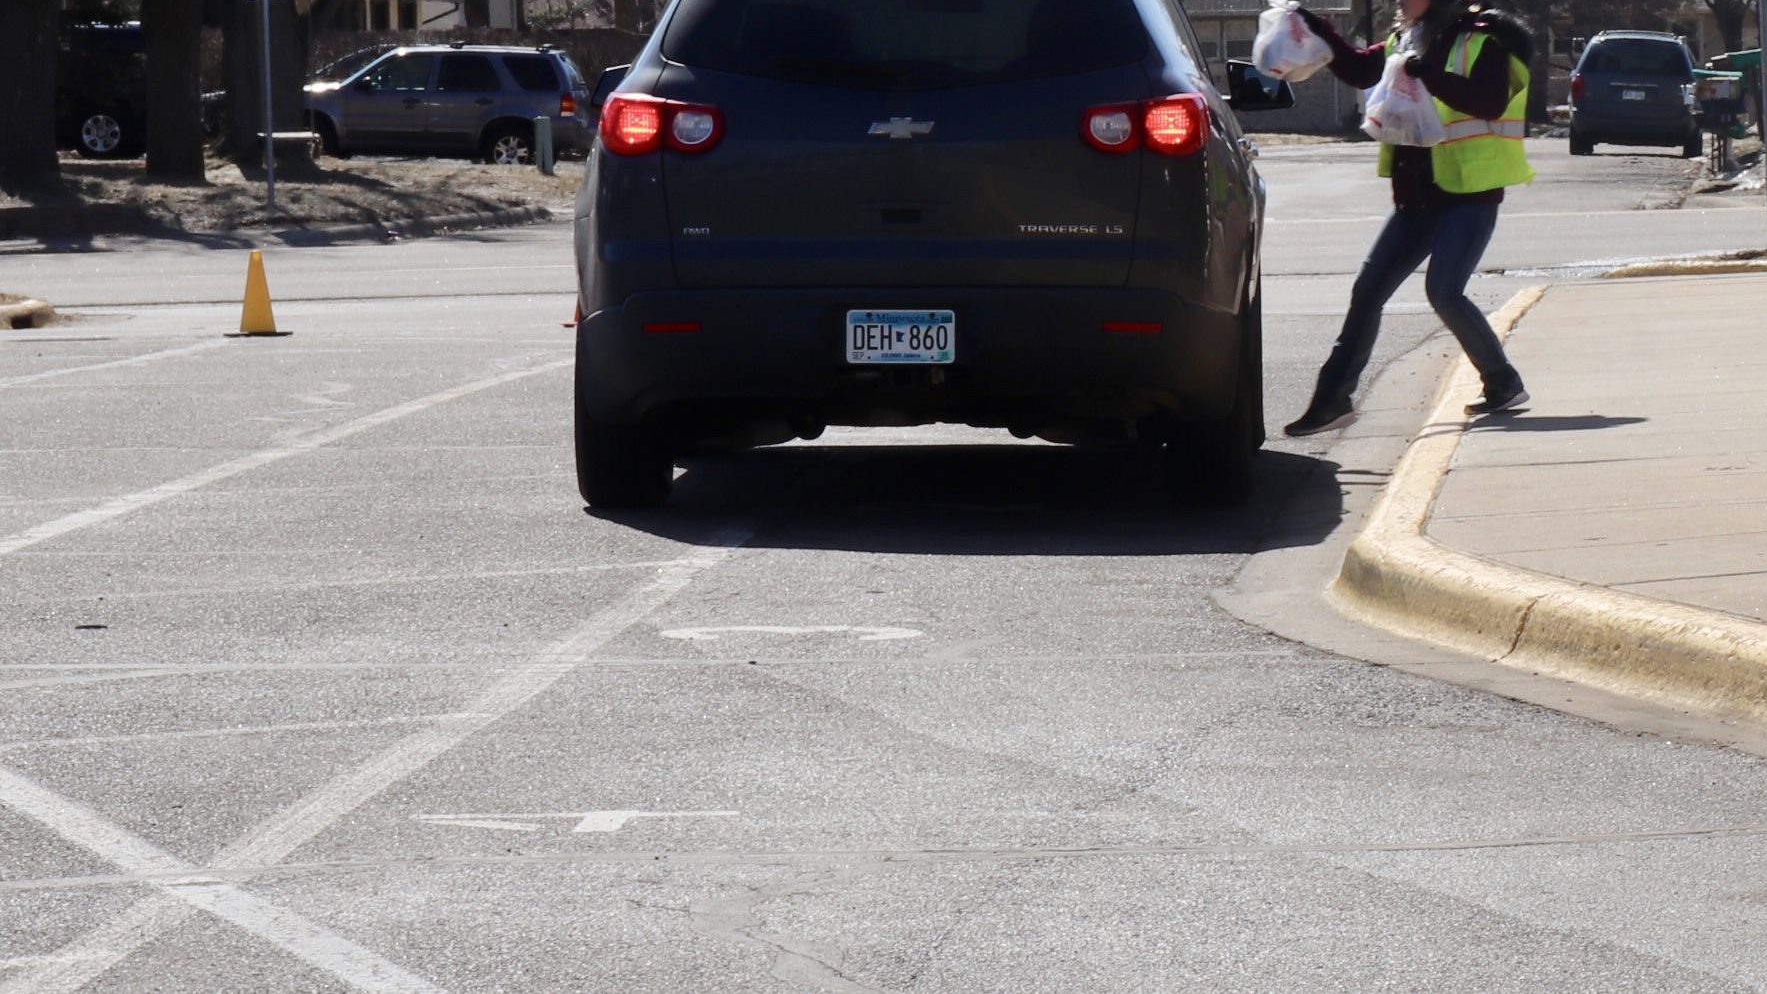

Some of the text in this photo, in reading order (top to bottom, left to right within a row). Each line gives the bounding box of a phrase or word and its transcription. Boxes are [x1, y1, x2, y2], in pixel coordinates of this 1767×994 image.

[1018, 225, 1124, 234] TRAVERSE LS
[876, 313, 926, 323] Minnesota
[853, 324, 948, 351] DEH 860
